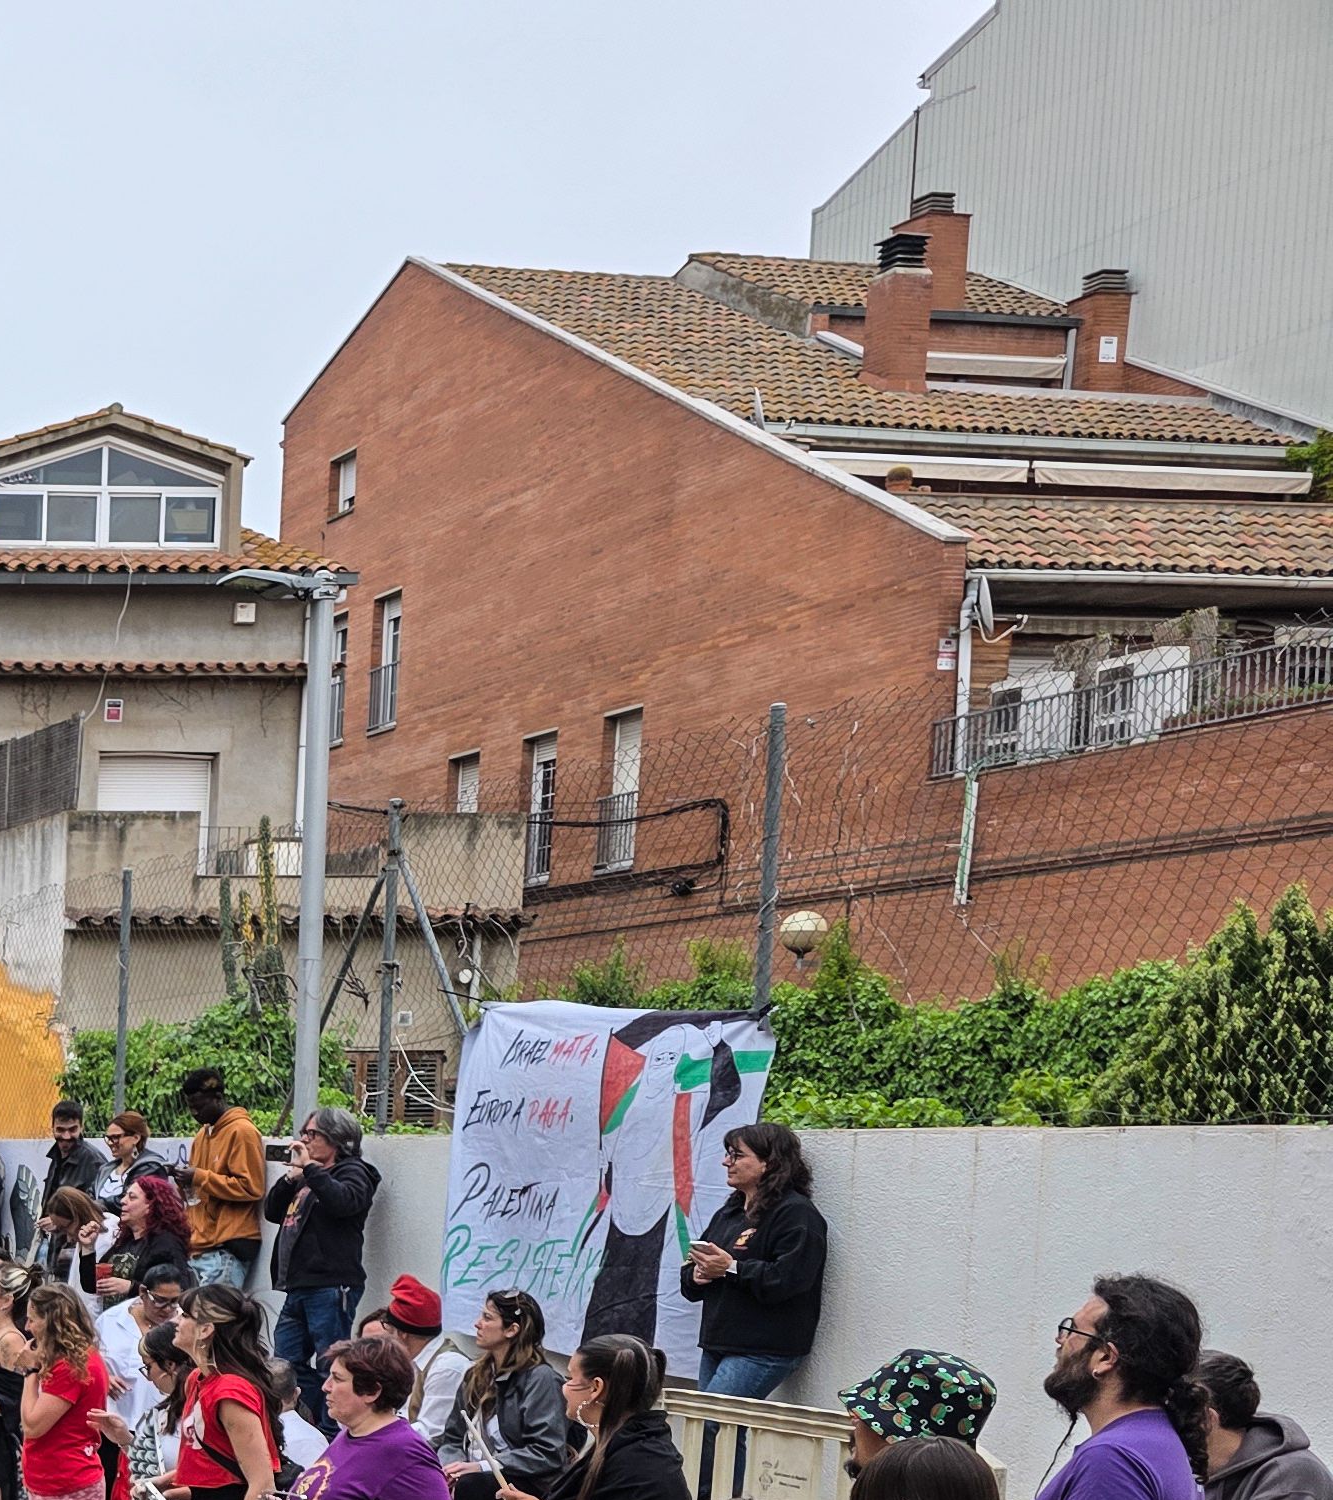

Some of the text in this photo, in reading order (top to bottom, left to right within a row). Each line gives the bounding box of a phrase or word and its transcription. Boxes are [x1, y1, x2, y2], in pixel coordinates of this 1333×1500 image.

[499, 1029, 552, 1072] ISRAEL
[462, 1089, 525, 1135] EUROPA
[450, 1161, 560, 1227] PALESTINA
